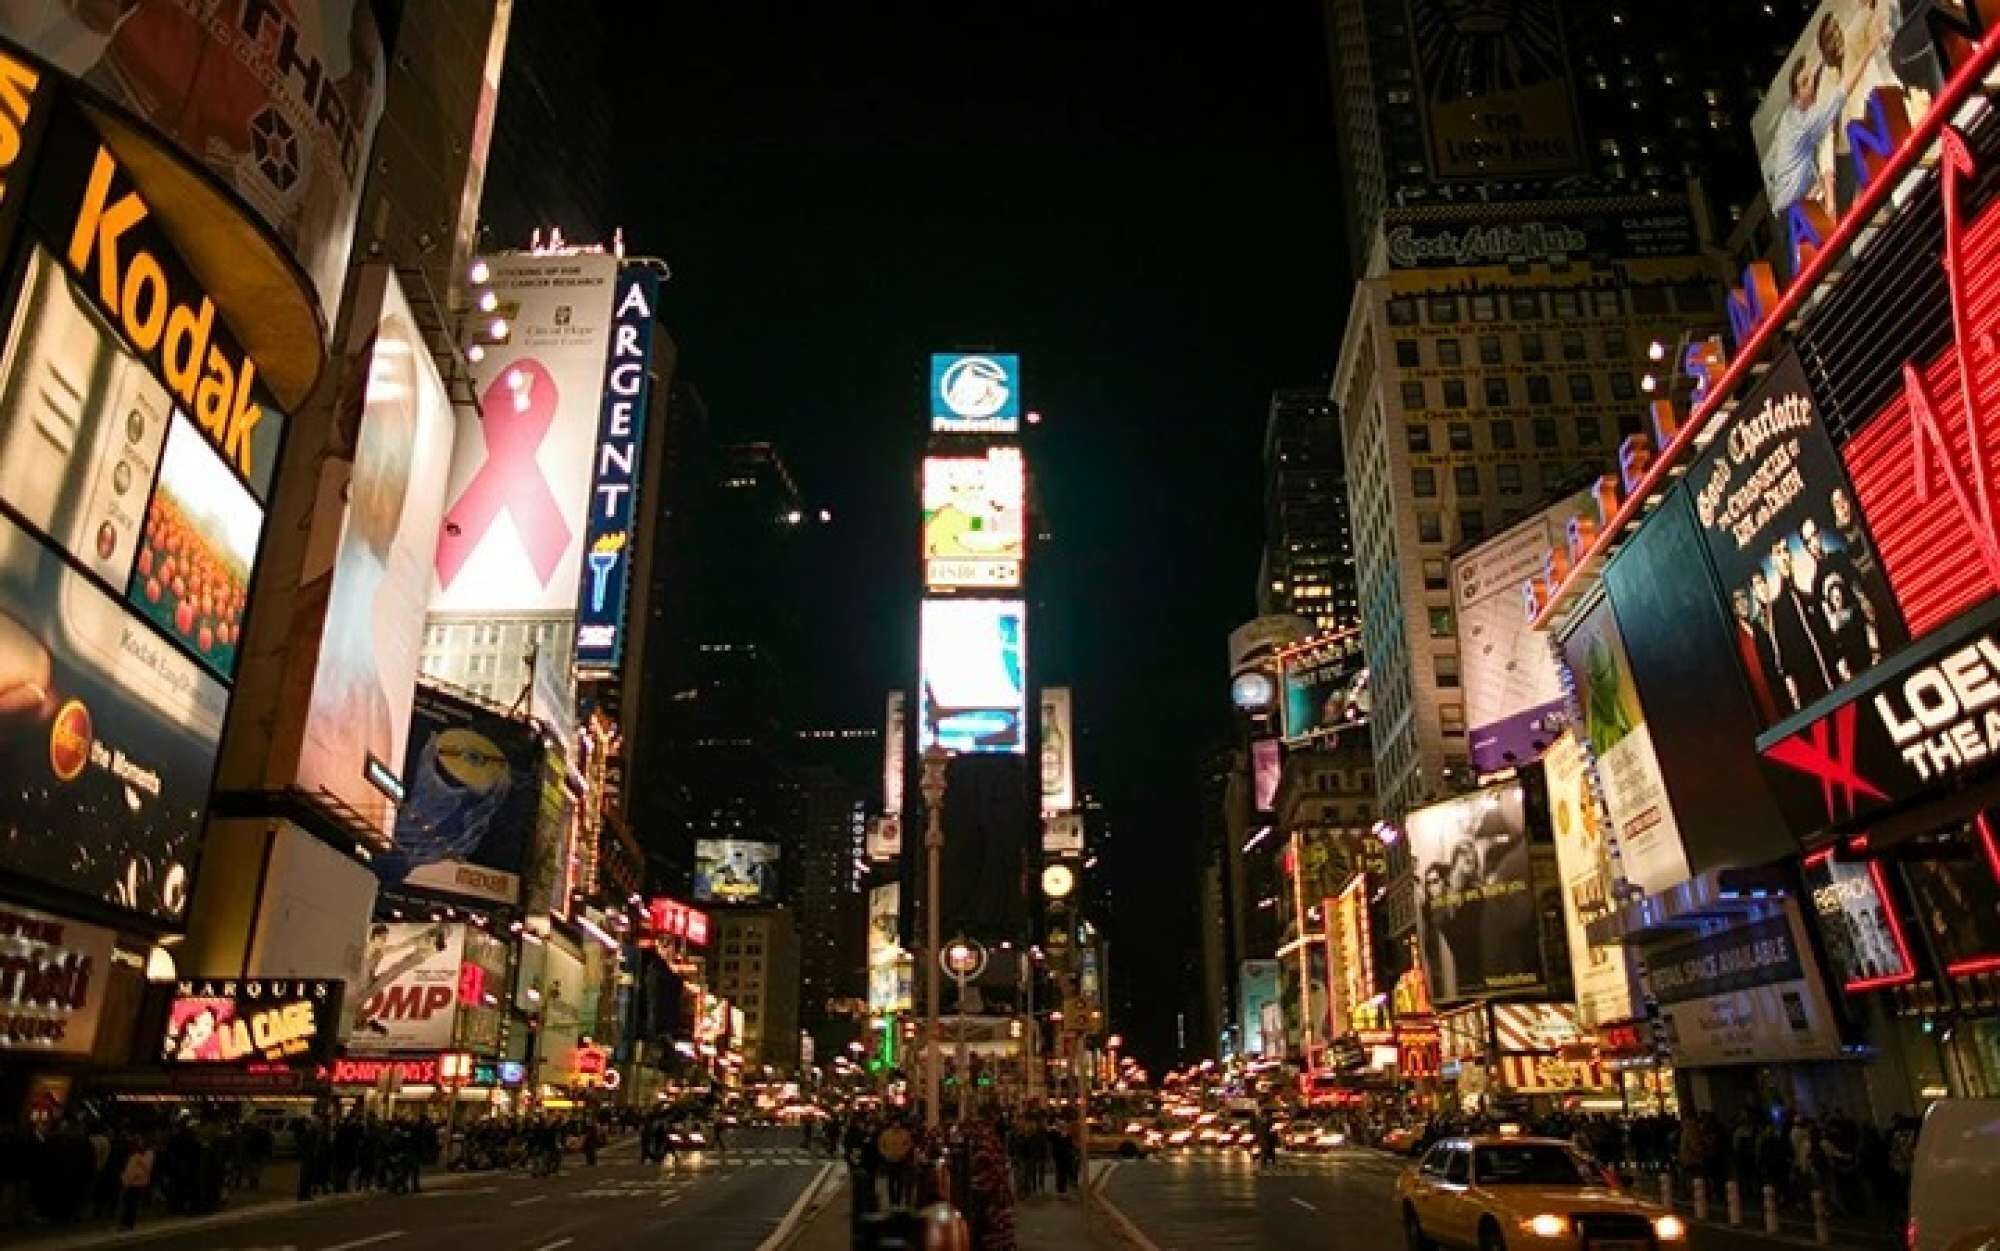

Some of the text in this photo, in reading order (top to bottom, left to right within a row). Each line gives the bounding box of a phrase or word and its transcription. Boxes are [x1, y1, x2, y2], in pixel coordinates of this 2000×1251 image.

[68, 144, 263, 478] Kodak
[596, 281, 651, 518] ARGENT
[1727, 392, 1812, 465] Charlotte
[177, 980, 328, 998] MARQUIS
[219, 1018, 254, 1060] LA
[252, 1000, 317, 1049] CAGE
